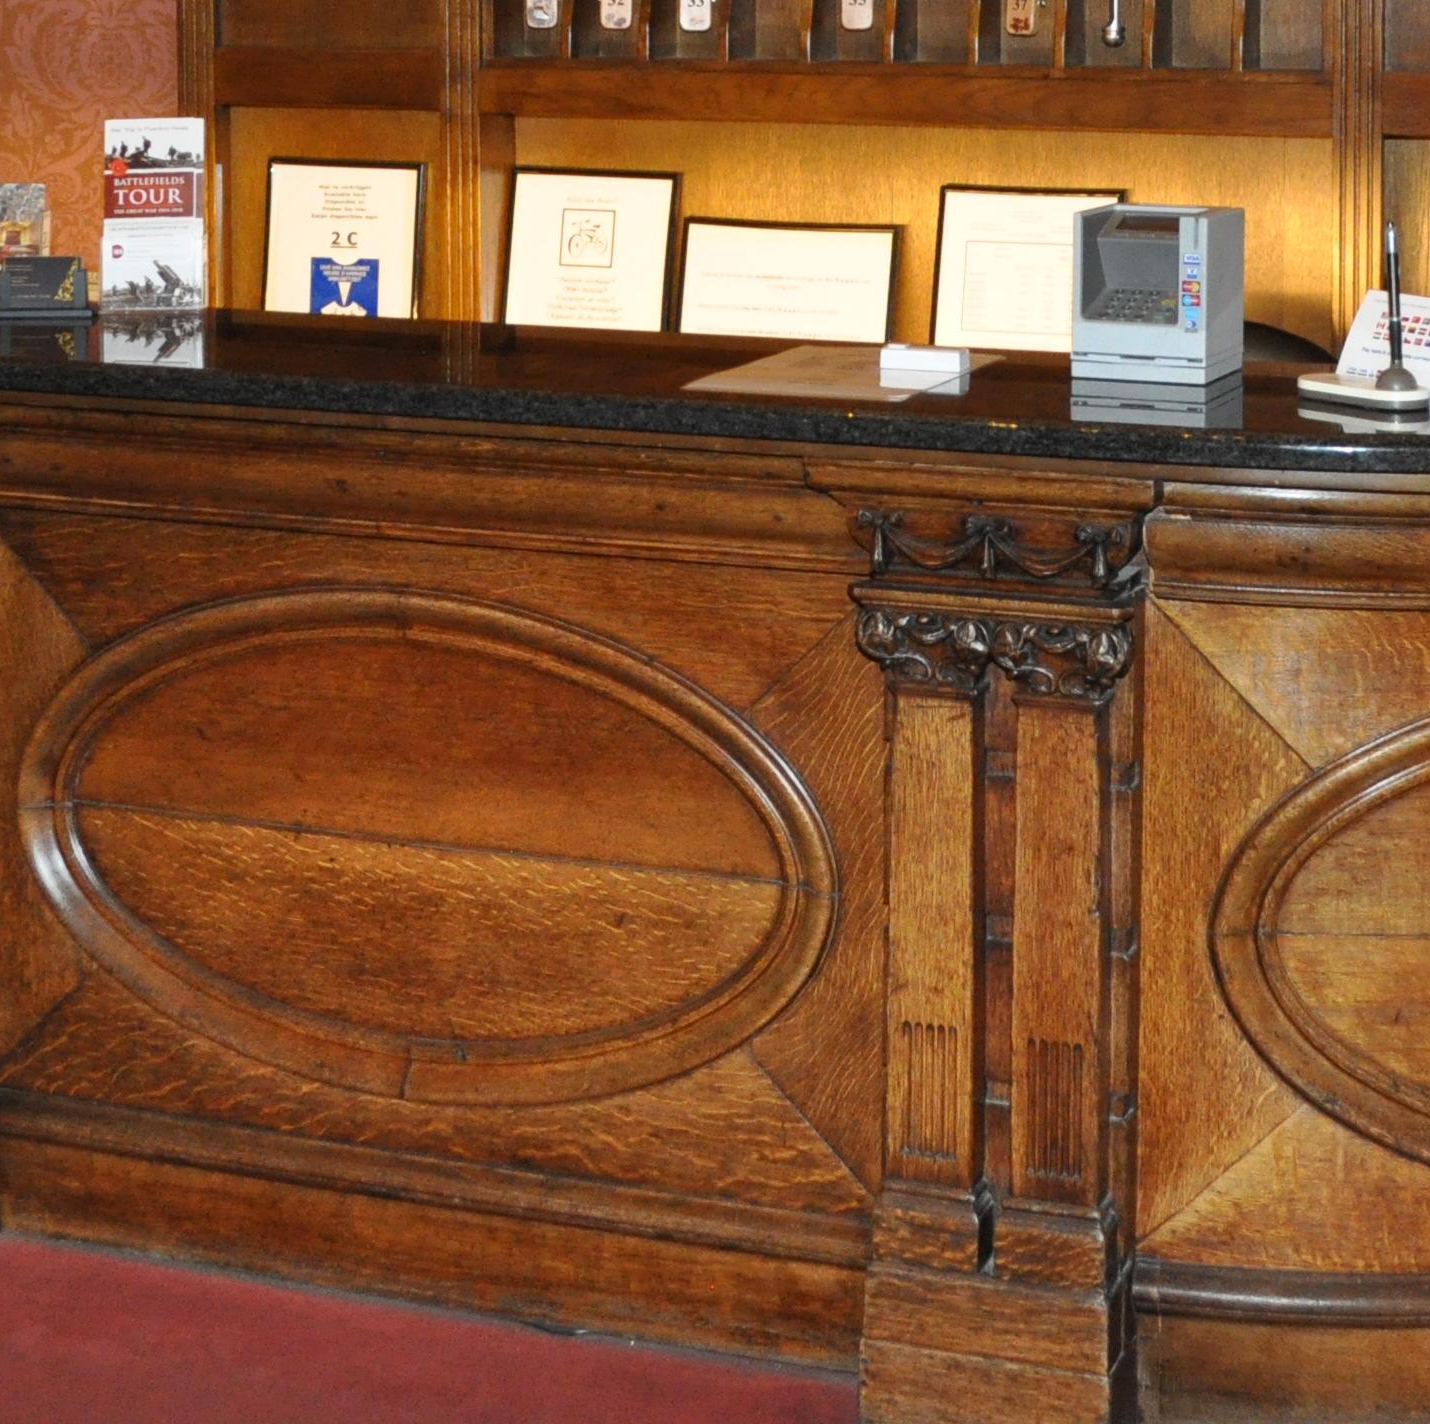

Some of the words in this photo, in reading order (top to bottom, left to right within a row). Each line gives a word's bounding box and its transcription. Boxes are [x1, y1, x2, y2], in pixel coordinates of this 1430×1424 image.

[114, 176, 185, 187] BATTLEFIELDS
[113, 188, 184, 205] TOUR
[331, 231, 341, 246] 2
[346, 231, 358, 246] C
